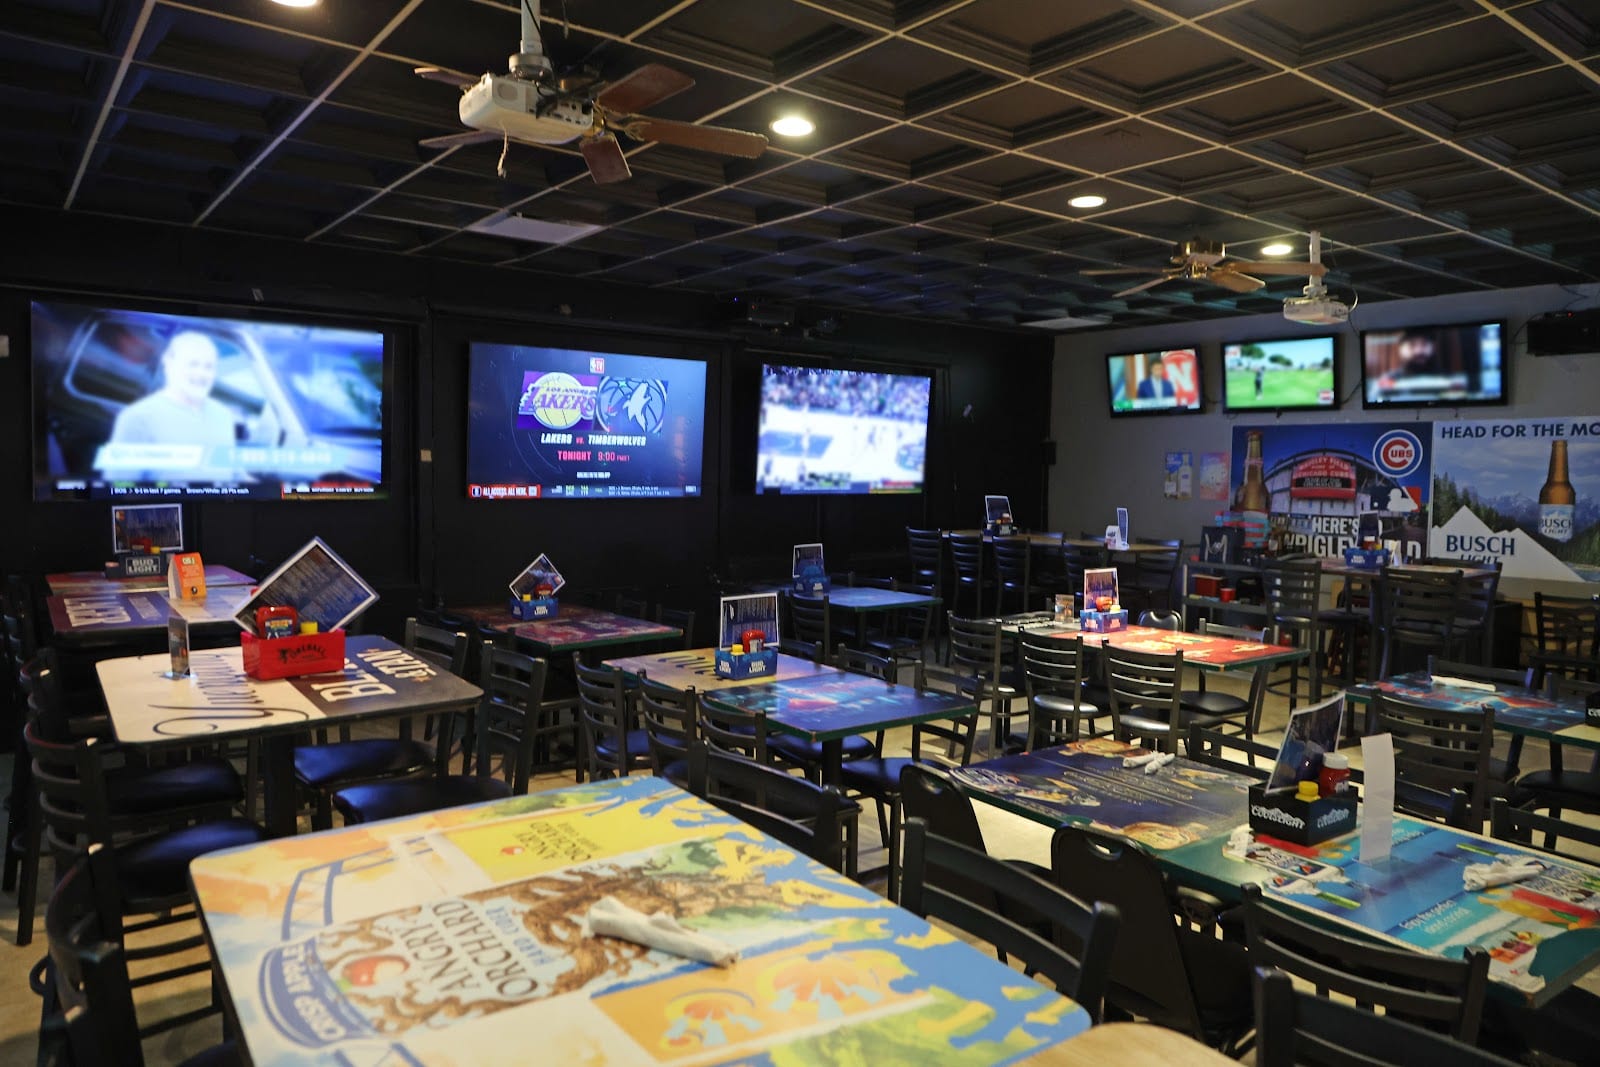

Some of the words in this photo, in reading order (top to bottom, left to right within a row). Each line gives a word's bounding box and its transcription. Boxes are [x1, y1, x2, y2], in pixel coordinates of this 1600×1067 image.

[519, 386, 596, 417] LAKERS
[1442, 425, 1487, 439] HEAD
[1492, 424, 1527, 438] FOR
[1532, 423, 1564, 437] THE
[540, 432, 573, 444] LAKERS
[588, 434, 647, 447] TIMBERWOLVES
[557, 450, 592, 462] TONIGHT
[1382, 439, 1413, 467] CUBS
[1311, 515, 1359, 534] HERE'S
[1446, 534, 1516, 556] BUSCH
[128, 565, 158, 573] LIGHT
[131, 558, 154, 567] BUD
[748, 664, 767, 674] LIGHT
[751, 660, 764, 668] BUD
[399, 922, 481, 992] ANGRY
[431, 900, 539, 998] ORCHARD
